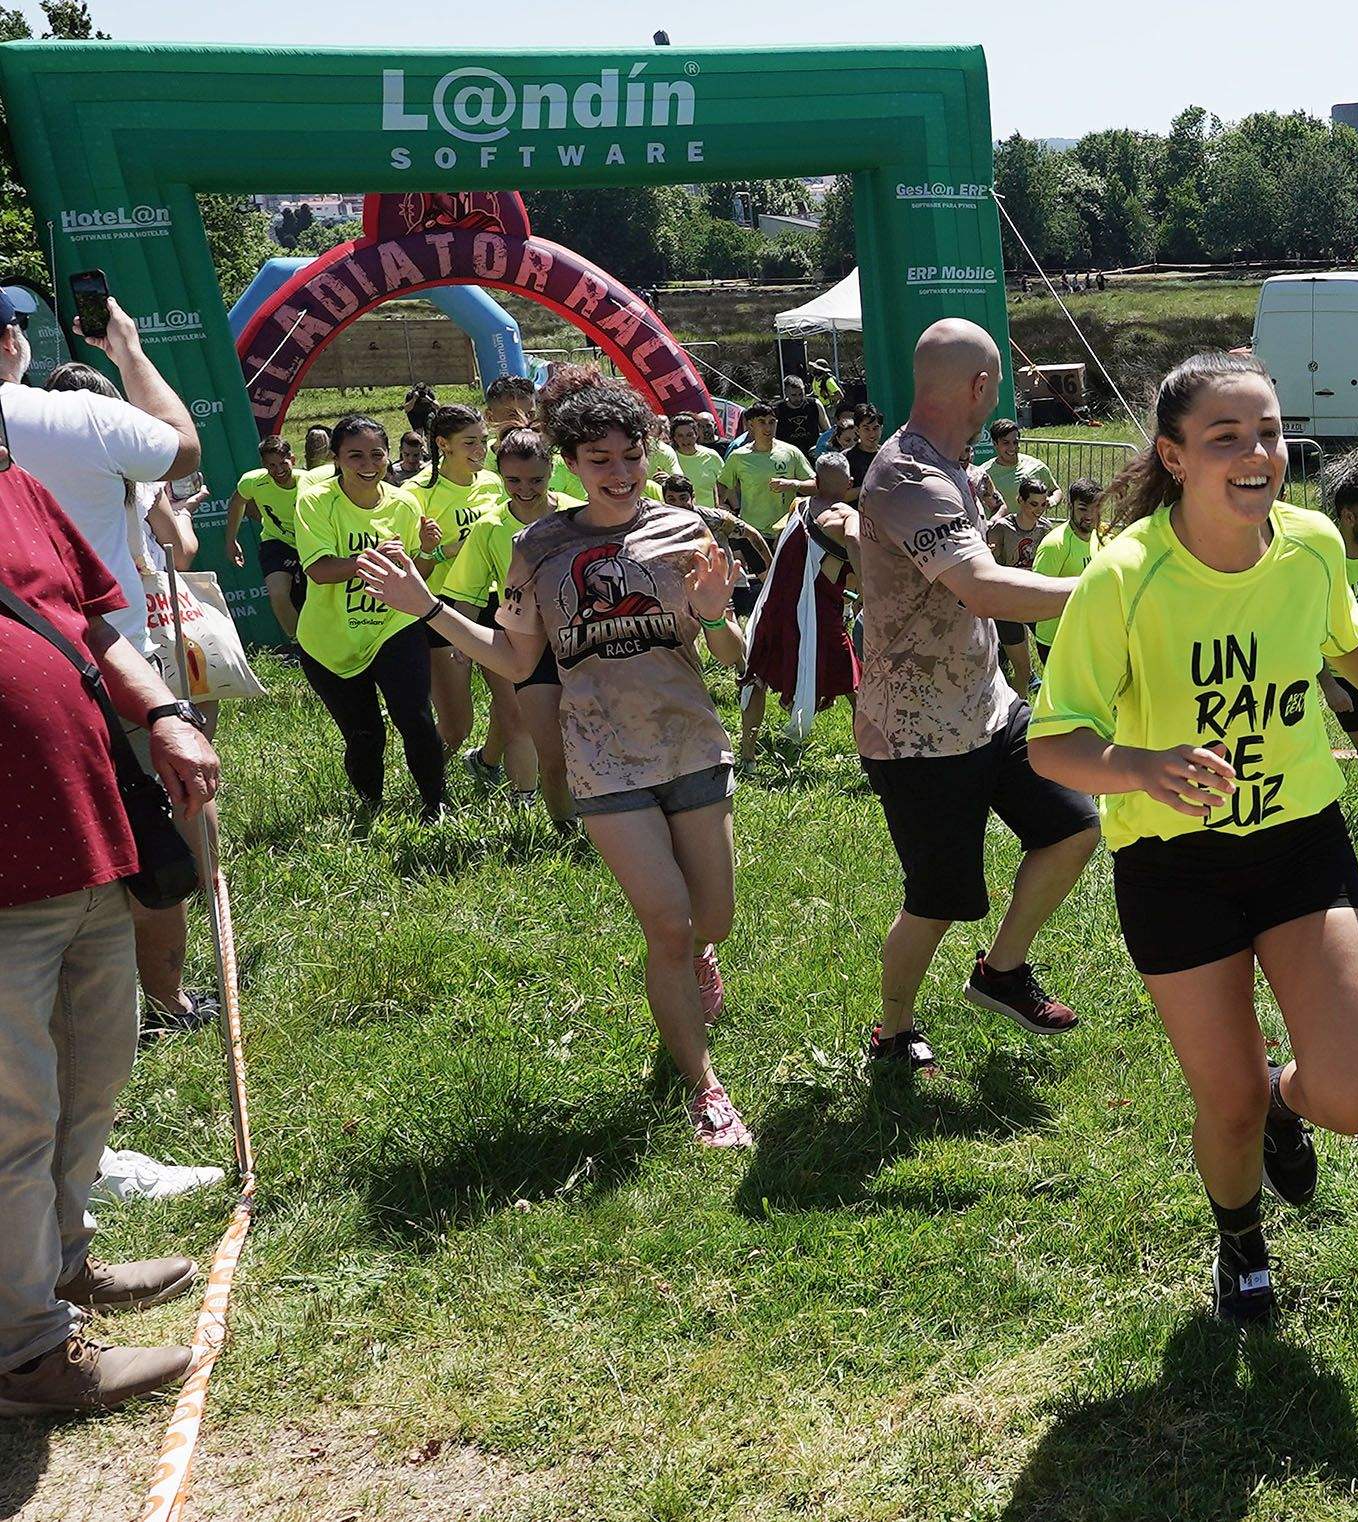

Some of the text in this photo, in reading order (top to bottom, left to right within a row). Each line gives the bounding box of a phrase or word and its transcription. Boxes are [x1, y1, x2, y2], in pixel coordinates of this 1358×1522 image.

[390, 141, 704, 169] SOFTWARE
[960, 184, 988, 196] ERP
[61, 205, 169, 227] HoteL@n
[70, 229, 169, 242] SOFTWARE PARA HOTELES
[907, 266, 995, 281] ERP Mobile
[247, 231, 554, 419] GLADIATOR
[565, 270, 700, 403] RACE
[348, 531, 379, 551] UN
[559, 613, 679, 658] GLADIATOR
[606, 640, 643, 656] RACE
[1191, 631, 1258, 687] UN
